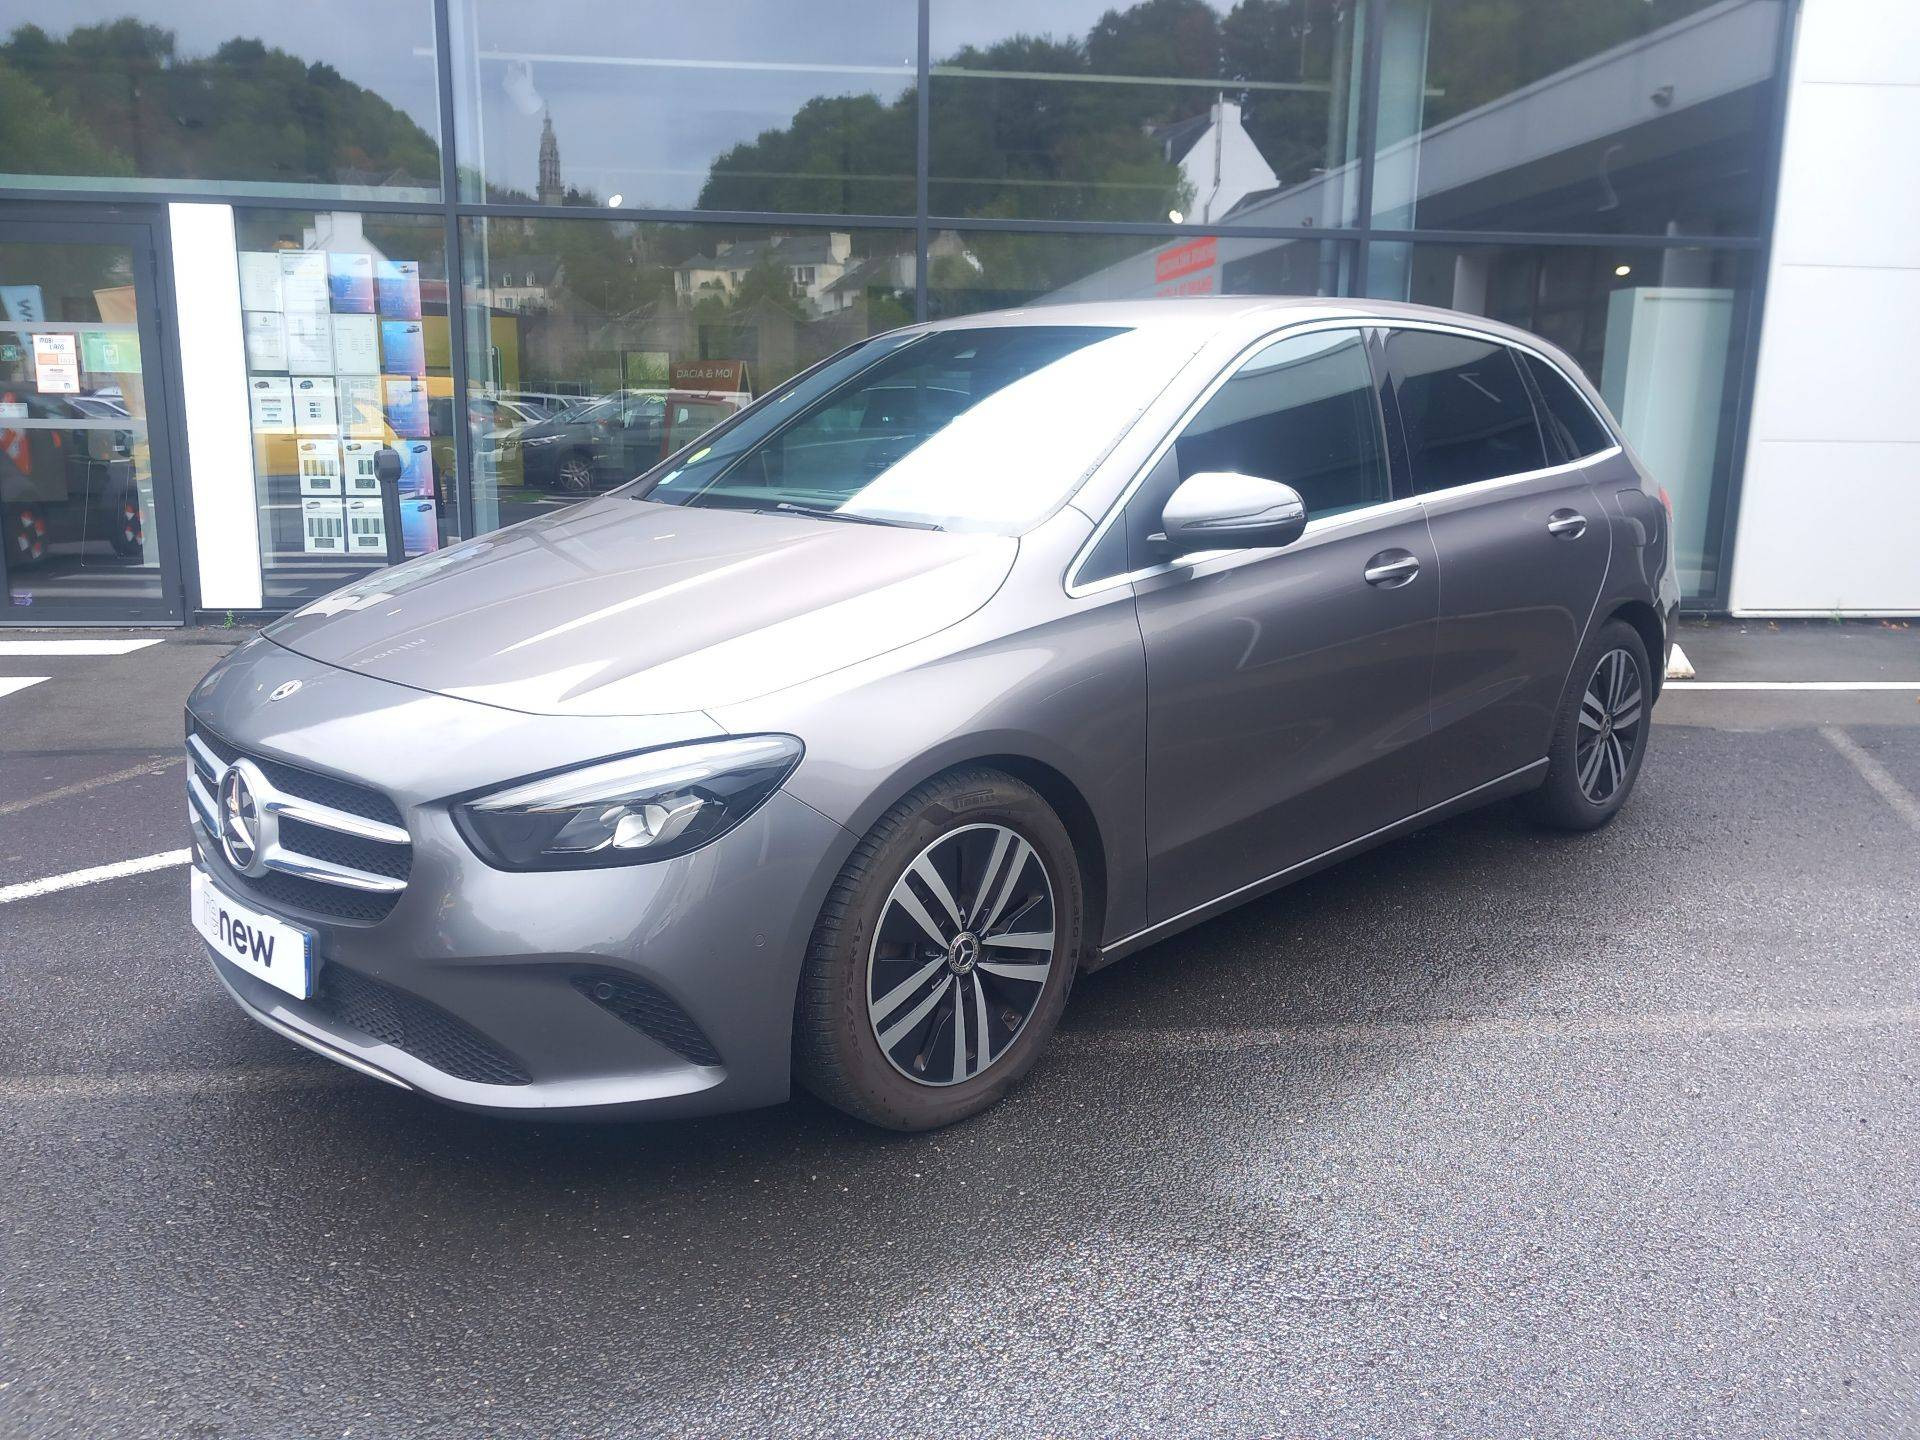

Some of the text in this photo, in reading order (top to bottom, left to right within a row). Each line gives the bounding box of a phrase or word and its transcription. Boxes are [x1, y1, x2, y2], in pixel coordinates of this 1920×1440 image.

[676, 368, 733, 379] DACIA & MOI
